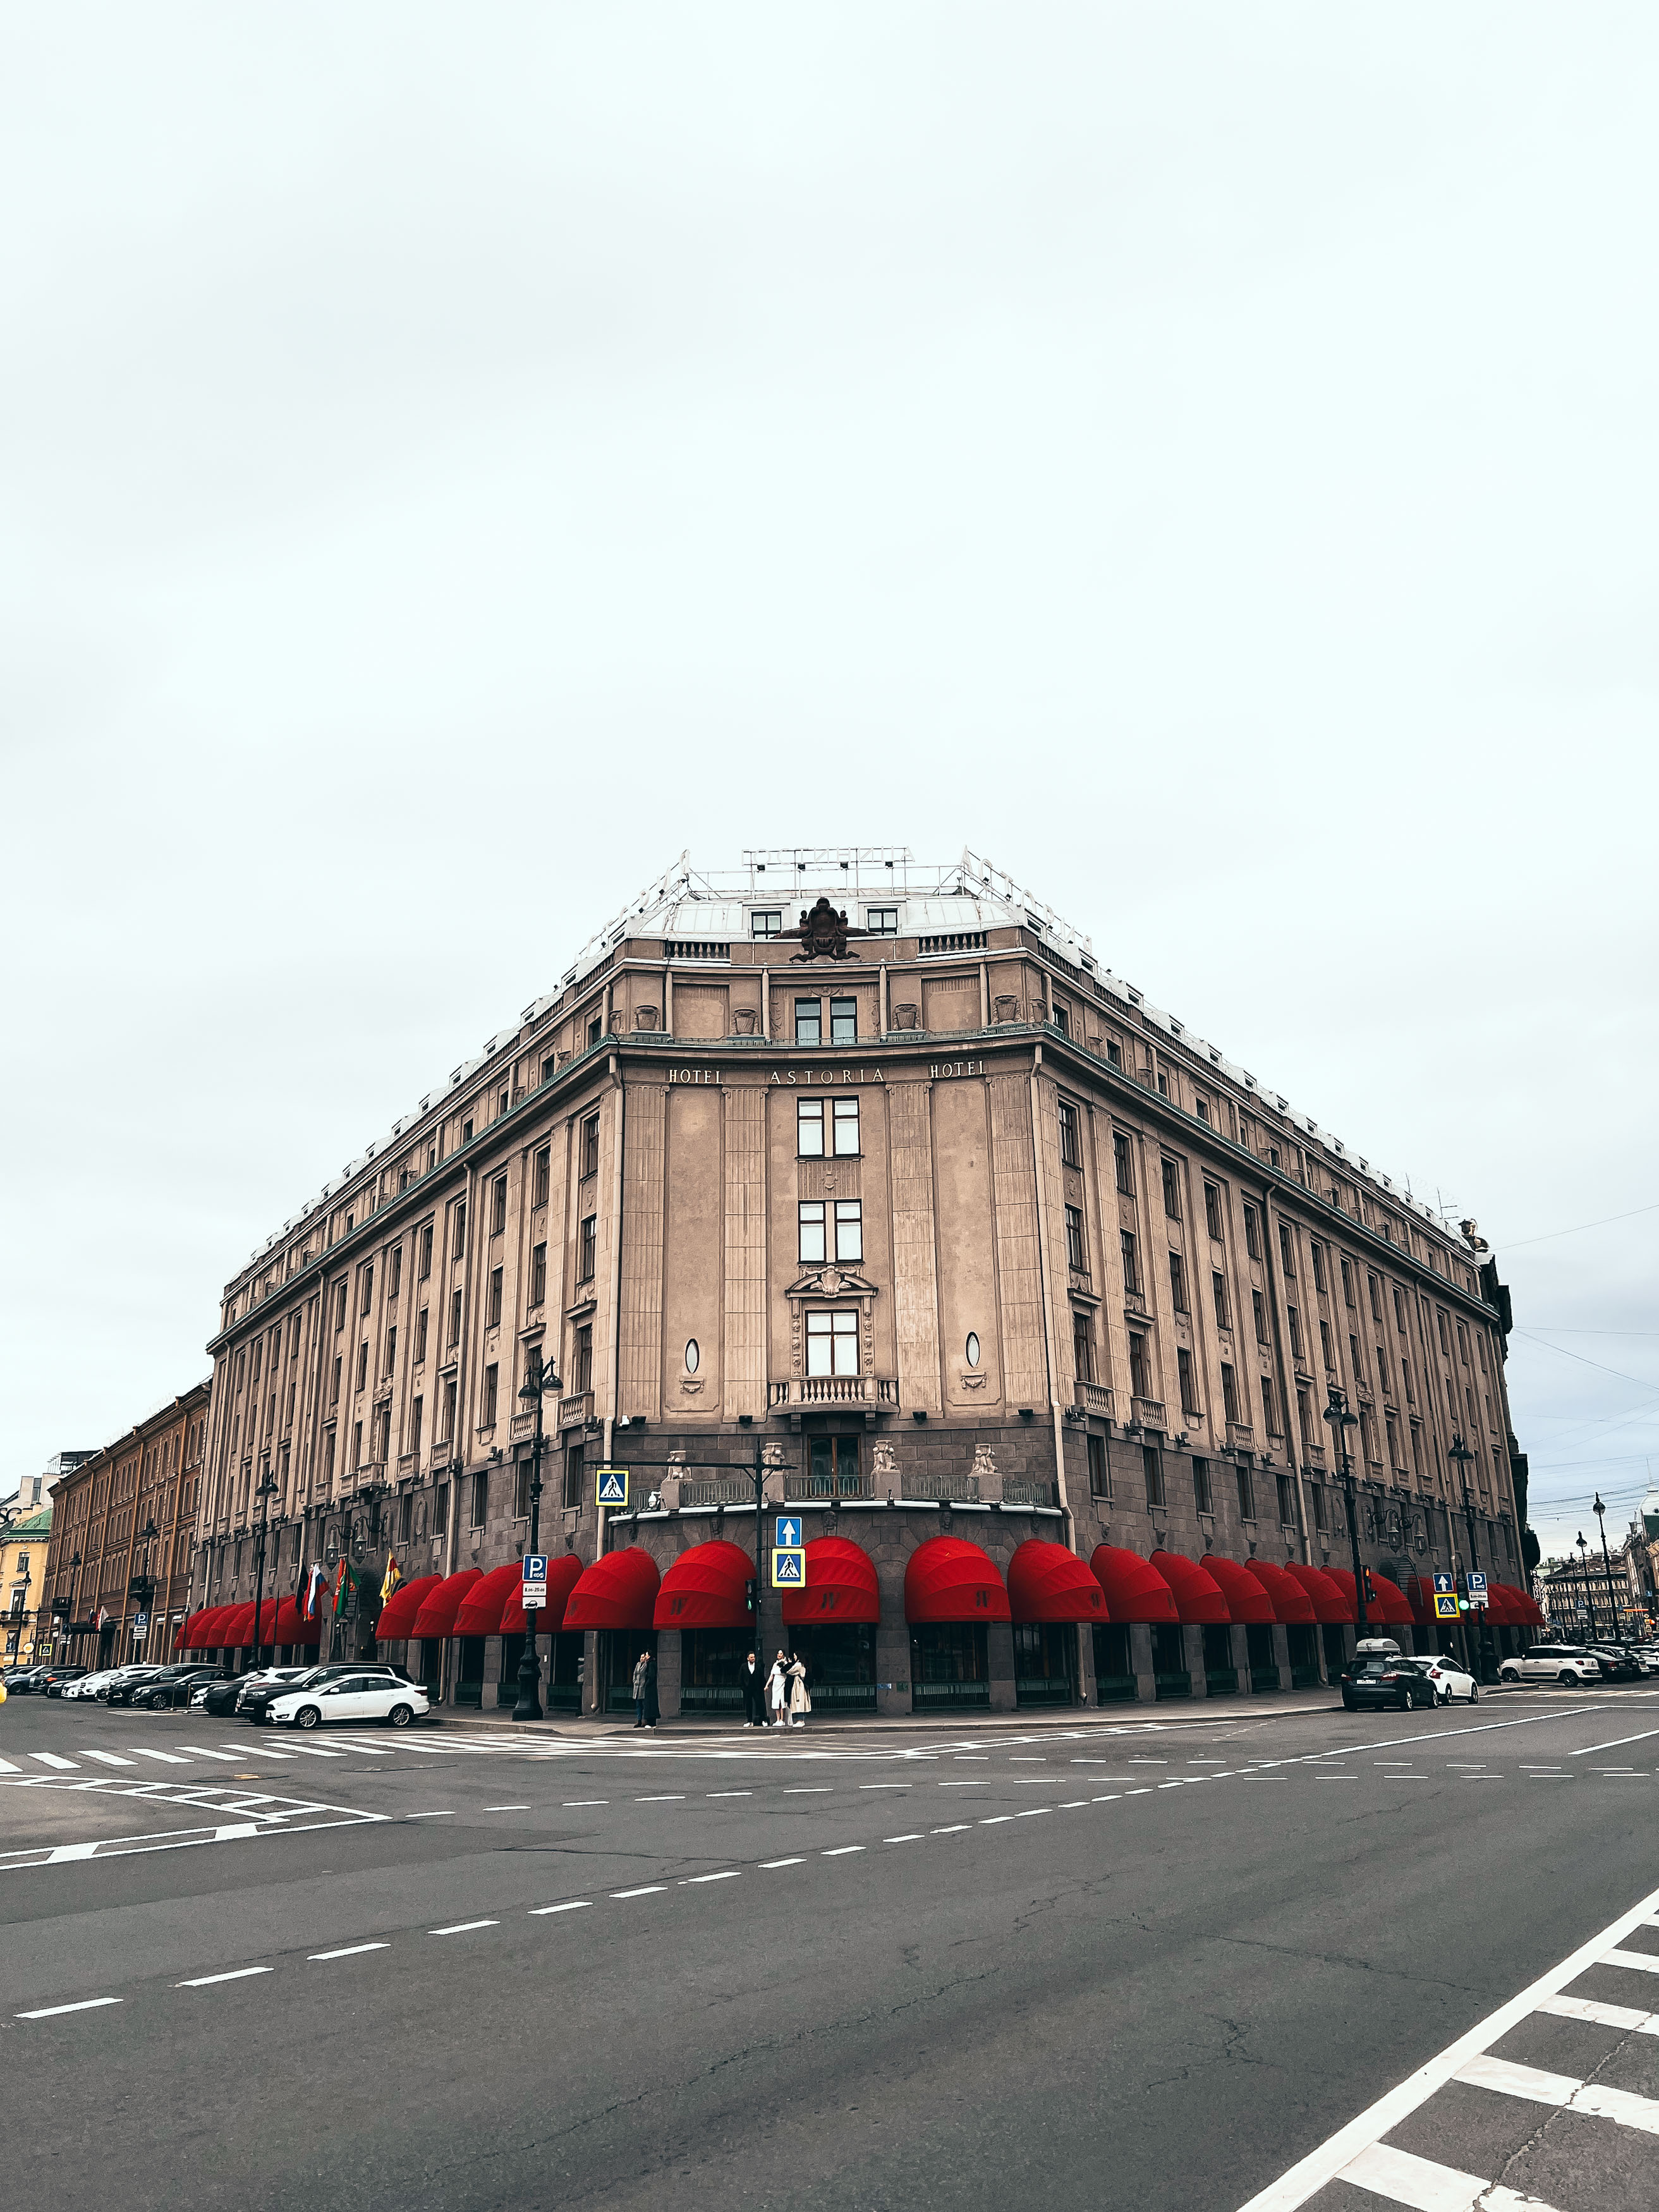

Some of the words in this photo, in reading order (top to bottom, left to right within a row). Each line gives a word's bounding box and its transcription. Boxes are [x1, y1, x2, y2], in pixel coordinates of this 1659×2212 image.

[741, 846, 915, 866] ГОСТИНИЦА
[669, 1069, 724, 1084] HOTEL
[769, 1068, 884, 1085] ASTORIA
[930, 1060, 987, 1078] HOTEL
[529, 1557, 544, 1579] P
[1472, 1574, 1483, 1589] P
[137, 1613, 146, 1624] P
